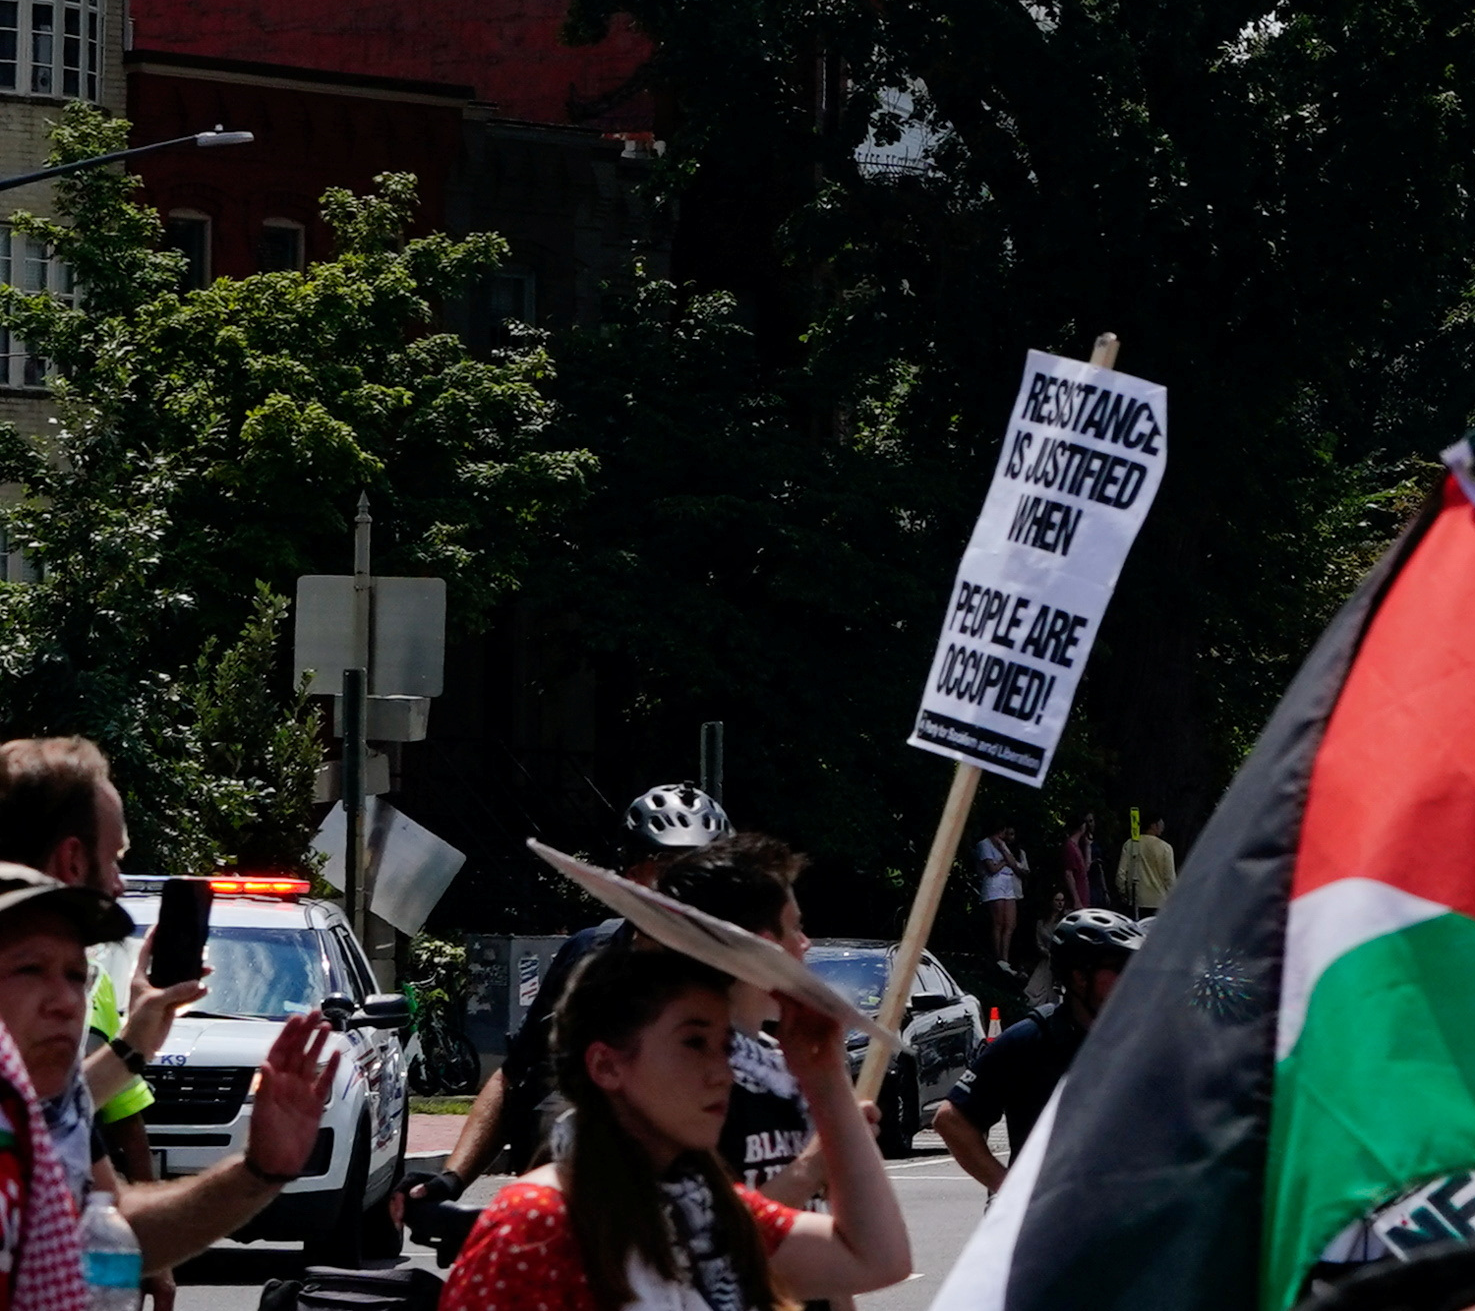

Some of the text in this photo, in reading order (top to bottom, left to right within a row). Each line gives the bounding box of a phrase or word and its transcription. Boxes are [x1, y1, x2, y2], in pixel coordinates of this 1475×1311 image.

[1004, 430, 1148, 510] IS JUSTIFIED
[1008, 493, 1084, 557] WHEN
[949, 581, 1088, 669] PEOPLE ARE
[936, 643, 1056, 726] OCCUPIED!
[160, 1054, 187, 1068] K9
